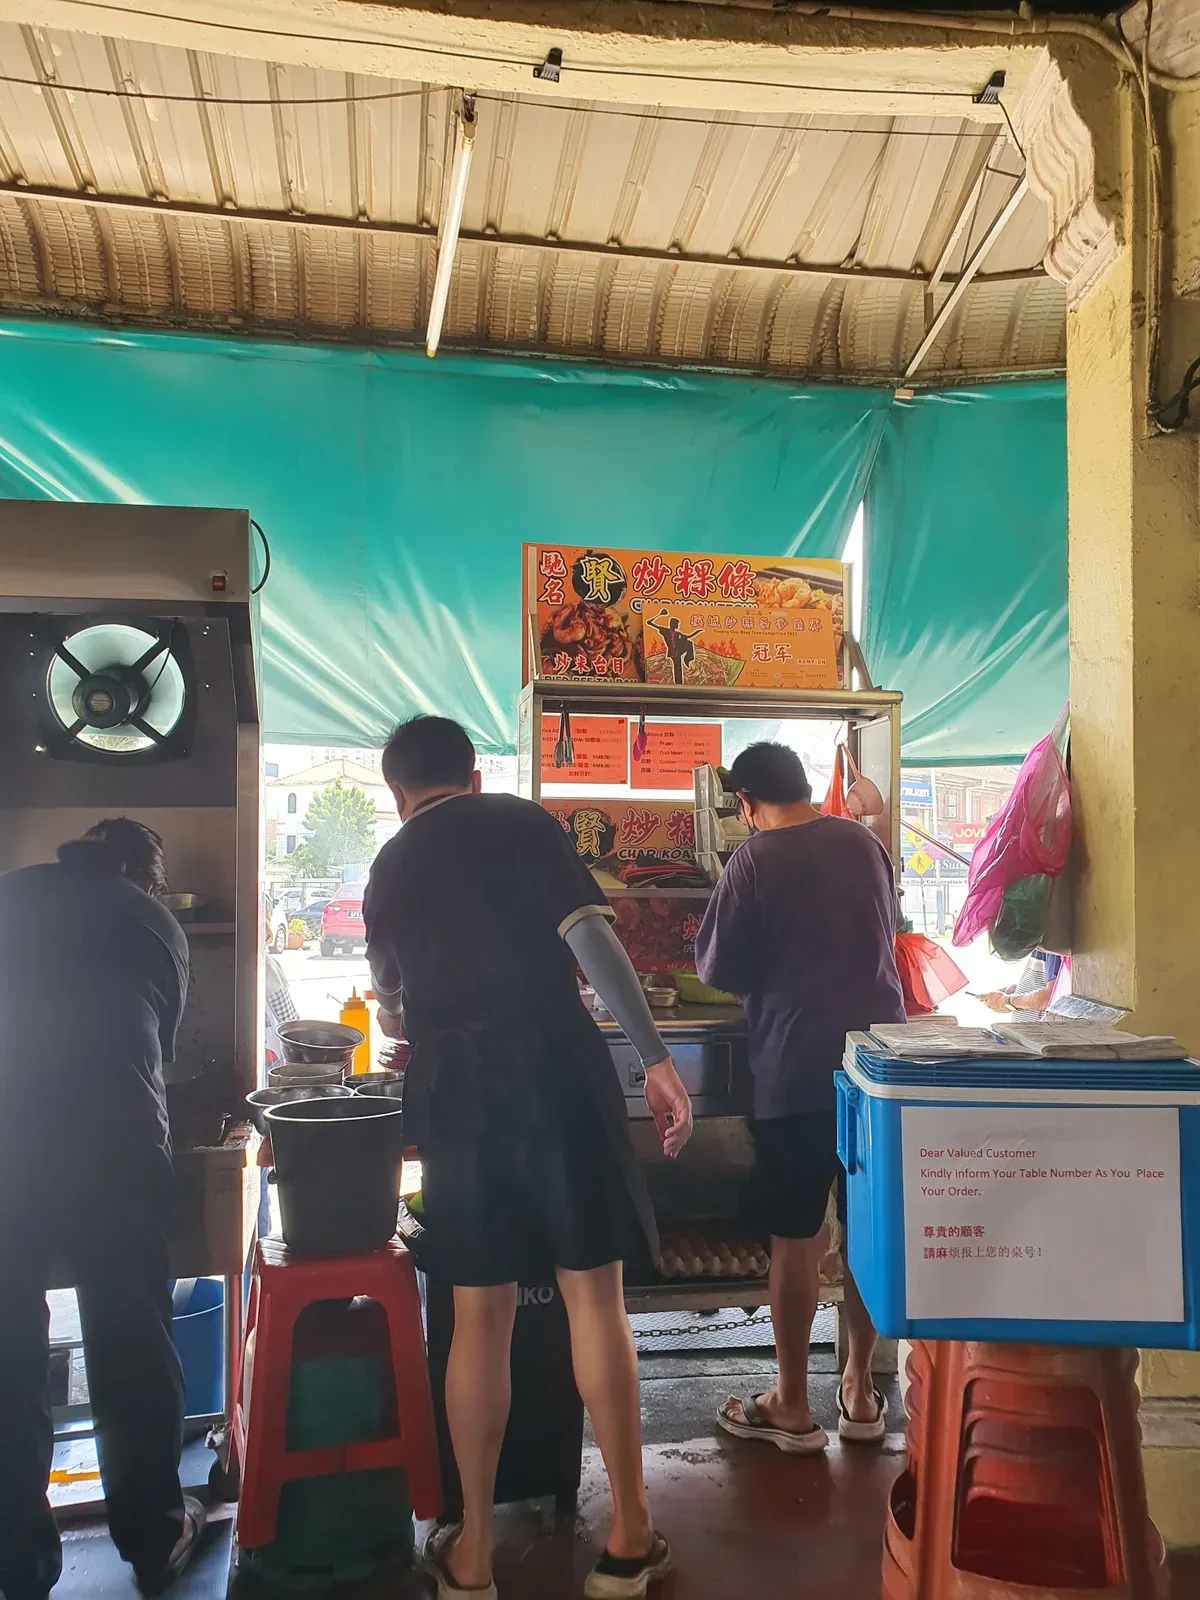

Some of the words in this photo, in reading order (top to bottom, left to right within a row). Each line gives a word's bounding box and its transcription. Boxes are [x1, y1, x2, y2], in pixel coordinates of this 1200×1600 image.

[580, 556, 624, 602] 賢
[632, 556, 757, 601] 炒粿條
[752, 643, 792, 663] 冠军
[659, 848, 695, 860] KOA
[920, 1149, 944, 1158] Dear
[947, 1149, 983, 1158] Valued
[986, 1149, 1036, 1158] Customer
[920, 1168, 952, 1180] Kindly
[955, 1168, 990, 1178] Inform
[992, 1169, 1017, 1178] Your
[1020, 1168, 1047, 1178] Table
[1050, 1168, 1092, 1178] Number
[1095, 1169, 1107, 1178] As
[1111, 1169, 1130, 1178] You
[1137, 1168, 1164, 1178] Place
[921, 1187, 945, 1196] Your
[948, 1186, 982, 1196] Order.
